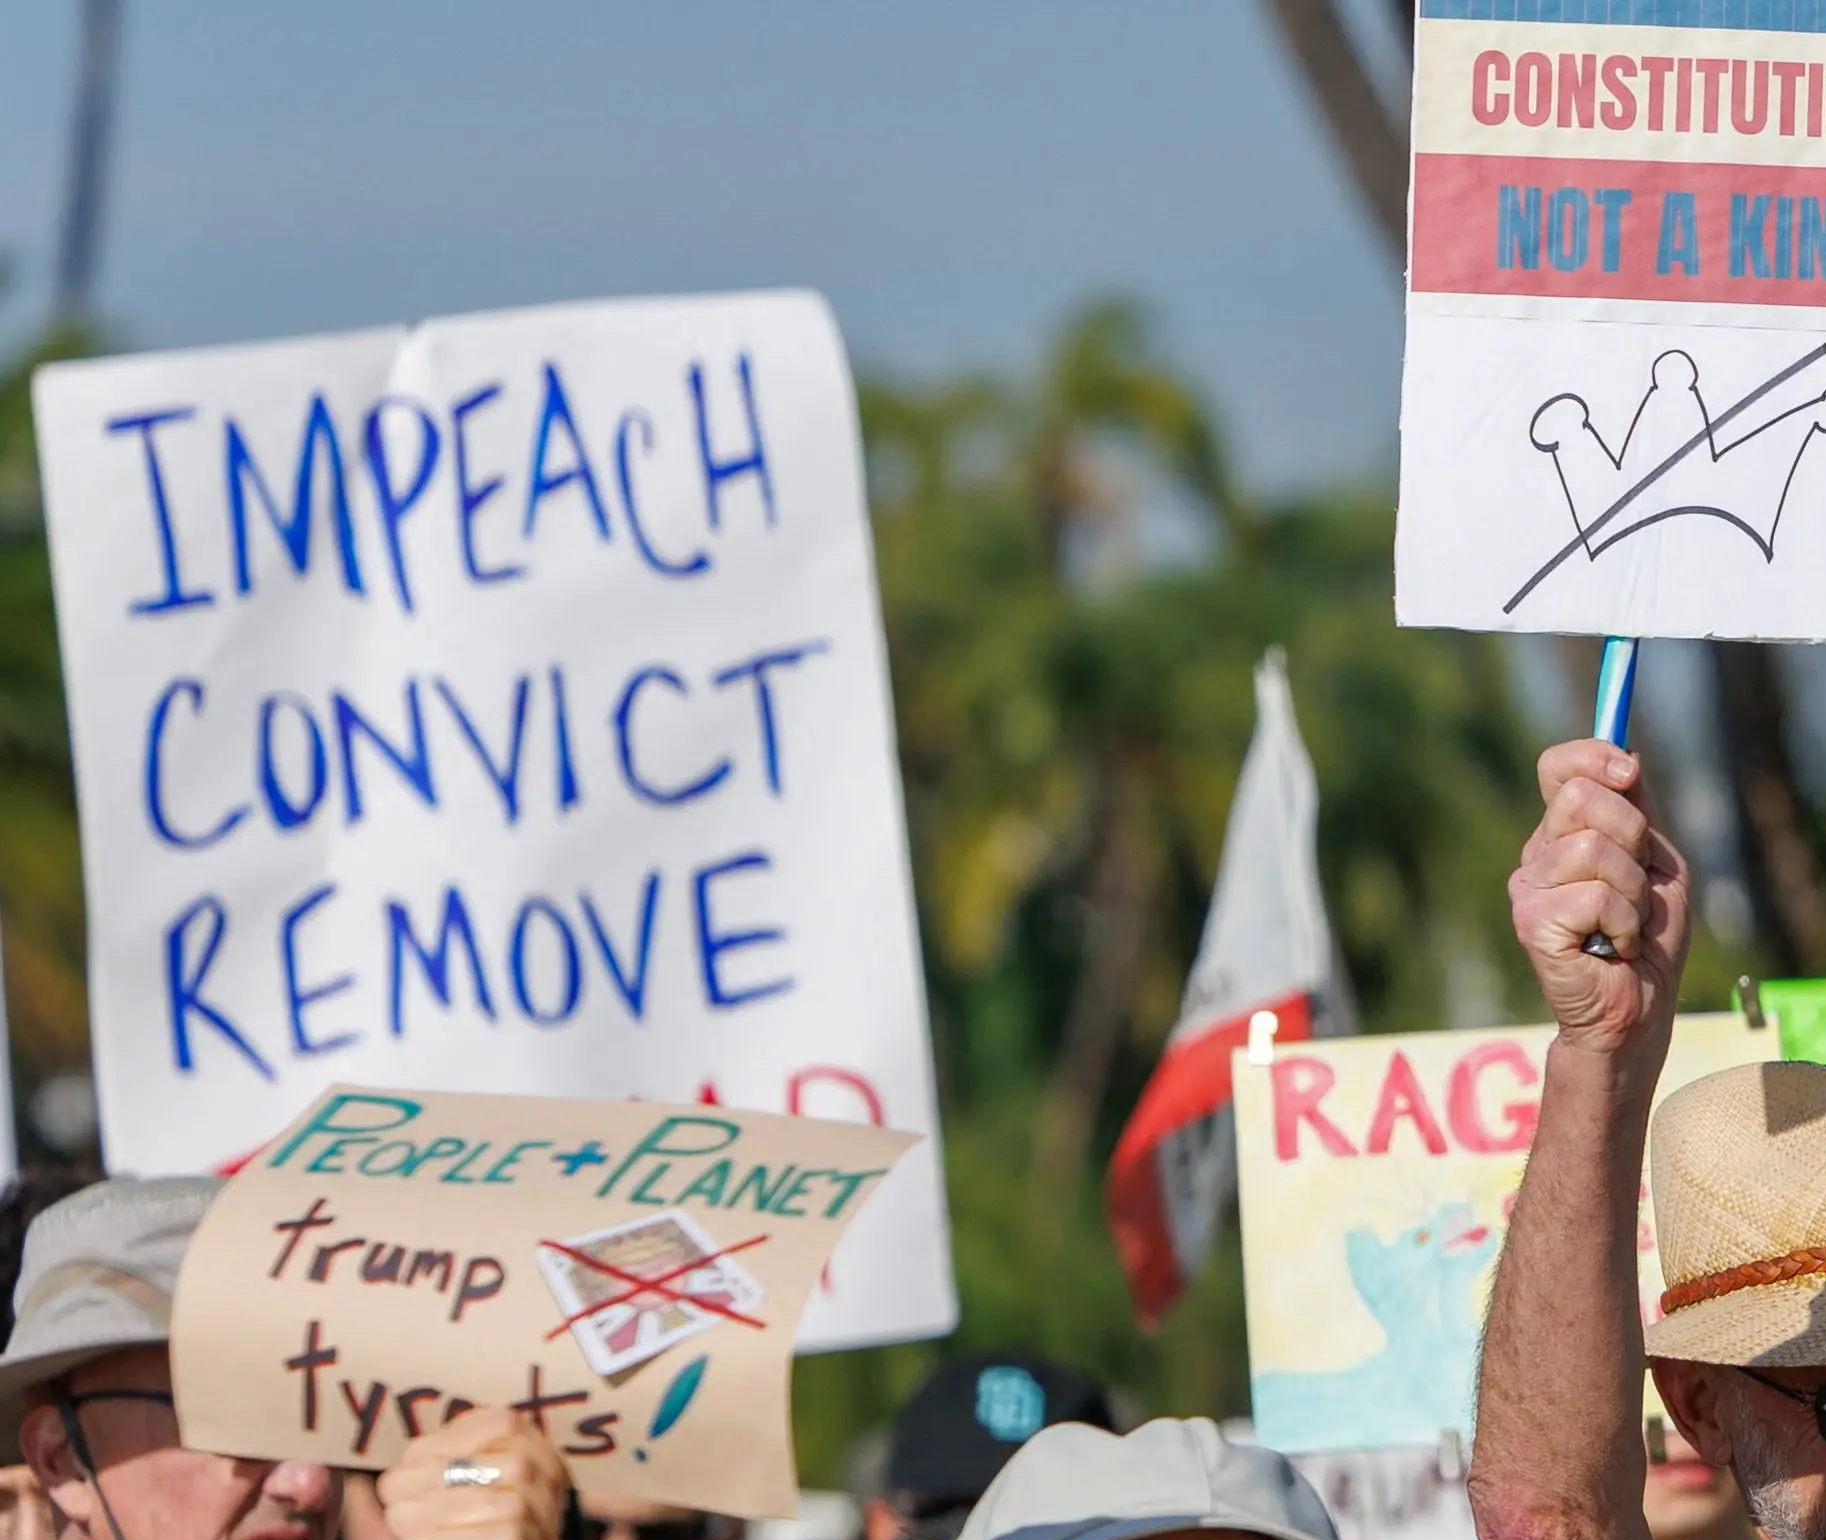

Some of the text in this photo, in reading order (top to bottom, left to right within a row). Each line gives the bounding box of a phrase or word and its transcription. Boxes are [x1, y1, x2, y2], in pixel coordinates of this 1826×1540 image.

[1496, 184, 1632, 274] NOT
[1655, 191, 1699, 277] A
[105, 351, 778, 621] IMPEACH
[143, 636, 831, 850] CONVICT
[163, 850, 797, 1082] REMOVE
[268, 1094, 552, 1184] PEOPLE
[595, 1114, 892, 1220] PLANET
[270, 1199, 505, 1322] trump
